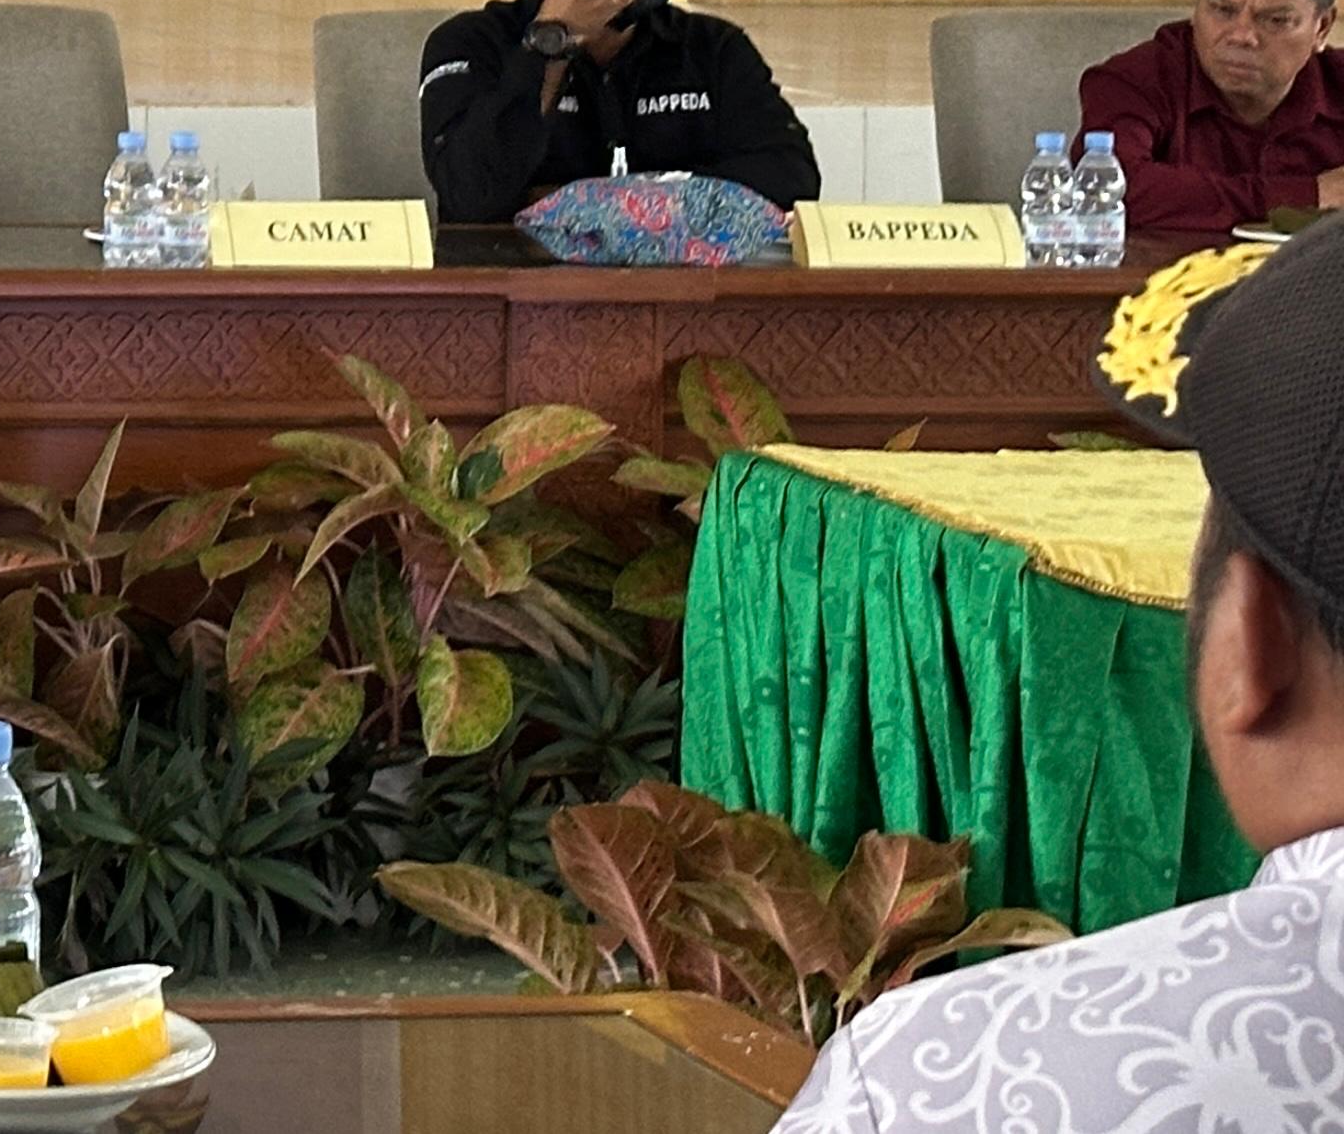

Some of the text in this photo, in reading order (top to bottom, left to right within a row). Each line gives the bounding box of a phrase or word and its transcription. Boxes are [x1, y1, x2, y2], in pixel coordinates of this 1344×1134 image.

[637, 92, 711, 115] BAPPEDA
[267, 221, 372, 242] CAMAT
[847, 221, 979, 240] BAPPEDA
